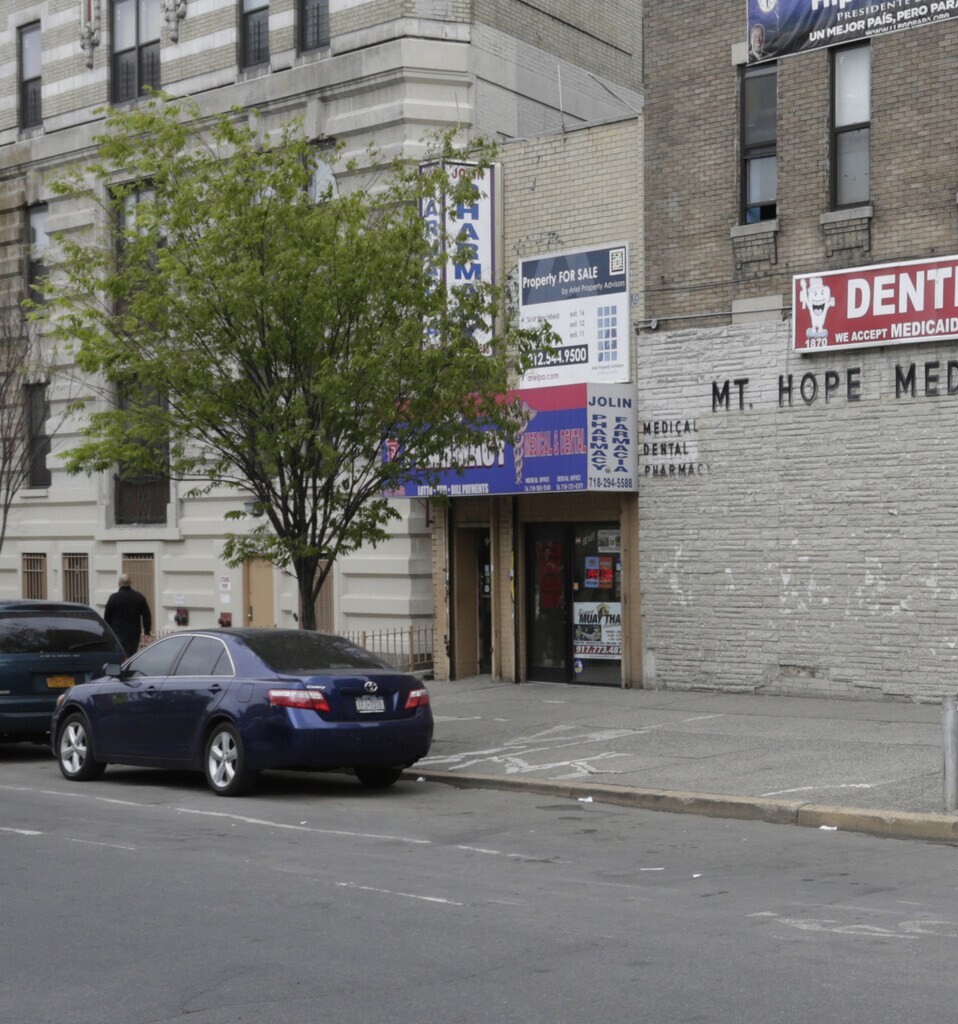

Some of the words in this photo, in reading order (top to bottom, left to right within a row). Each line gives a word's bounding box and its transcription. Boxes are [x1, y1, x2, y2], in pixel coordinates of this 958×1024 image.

[809, 32, 825, 42] UN
[826, 19, 866, 37] MEJOR
[896, 4, 928, 20] PERO
[452, 168, 485, 181] JOIN
[522, 273, 557, 289] Property
[559, 269, 576, 283] FOR
[577, 266, 598, 280] SALE
[561, 287, 568, 295] by
[581, 282, 603, 294] Property
[603, 279, 625, 289] Advisors
[834, 332, 849, 343] WE
[851, 328, 888, 342] ACCEPT
[804, 338, 828, 349] 1870
[711, 377, 753, 413] MT.
[778, 366, 862, 407] HOPE
[588, 396, 632, 409] JOLIN
[643, 420, 699, 436] MEDICAL
[524, 431, 553, 457] MEDICAL
[560, 428, 588, 456] DENTAL
[590, 414, 609, 471] PHARMACY
[612, 416, 630, 473] FARMACIA
[643, 442, 689, 456] DENTAL
[451, 484, 462, 495] BILL
[462, 483, 489, 494] PAYMENTS
[589, 477, 633, 489] 718-294-5588
[579, 613, 602, 624] MUAY
[604, 613, 622, 624] THA
[576, 645, 622, 654] 917.773.487
